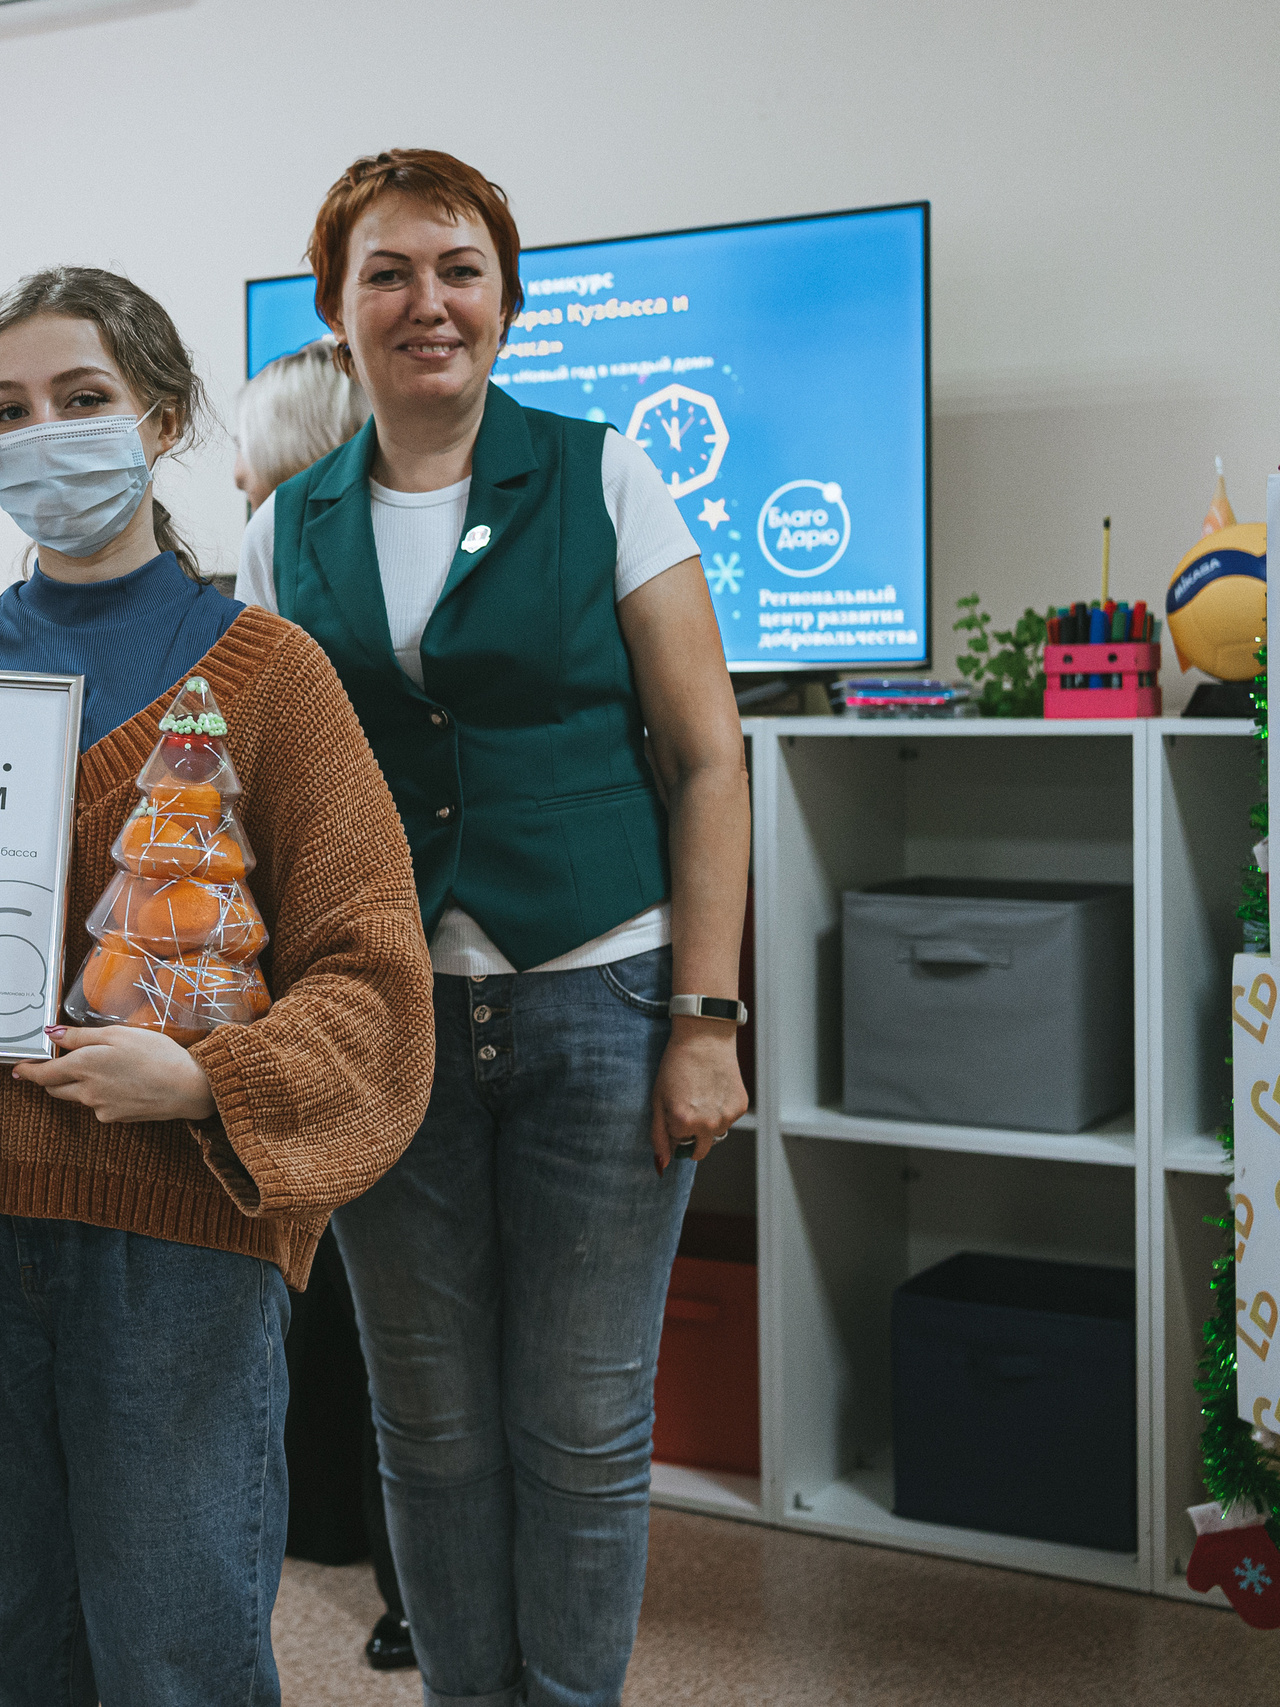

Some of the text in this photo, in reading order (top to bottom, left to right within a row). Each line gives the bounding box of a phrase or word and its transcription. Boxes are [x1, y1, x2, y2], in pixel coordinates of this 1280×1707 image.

[512, 295, 689, 332] ороз Кузбасса и
[497, 340, 563, 359] очка»
[768, 506, 829, 529] Благо
[776, 526, 840, 552] Дарю
[758, 585, 897, 607] Региональный
[758, 609, 905, 631] центр развития
[757, 628, 918, 652] добровольчества
